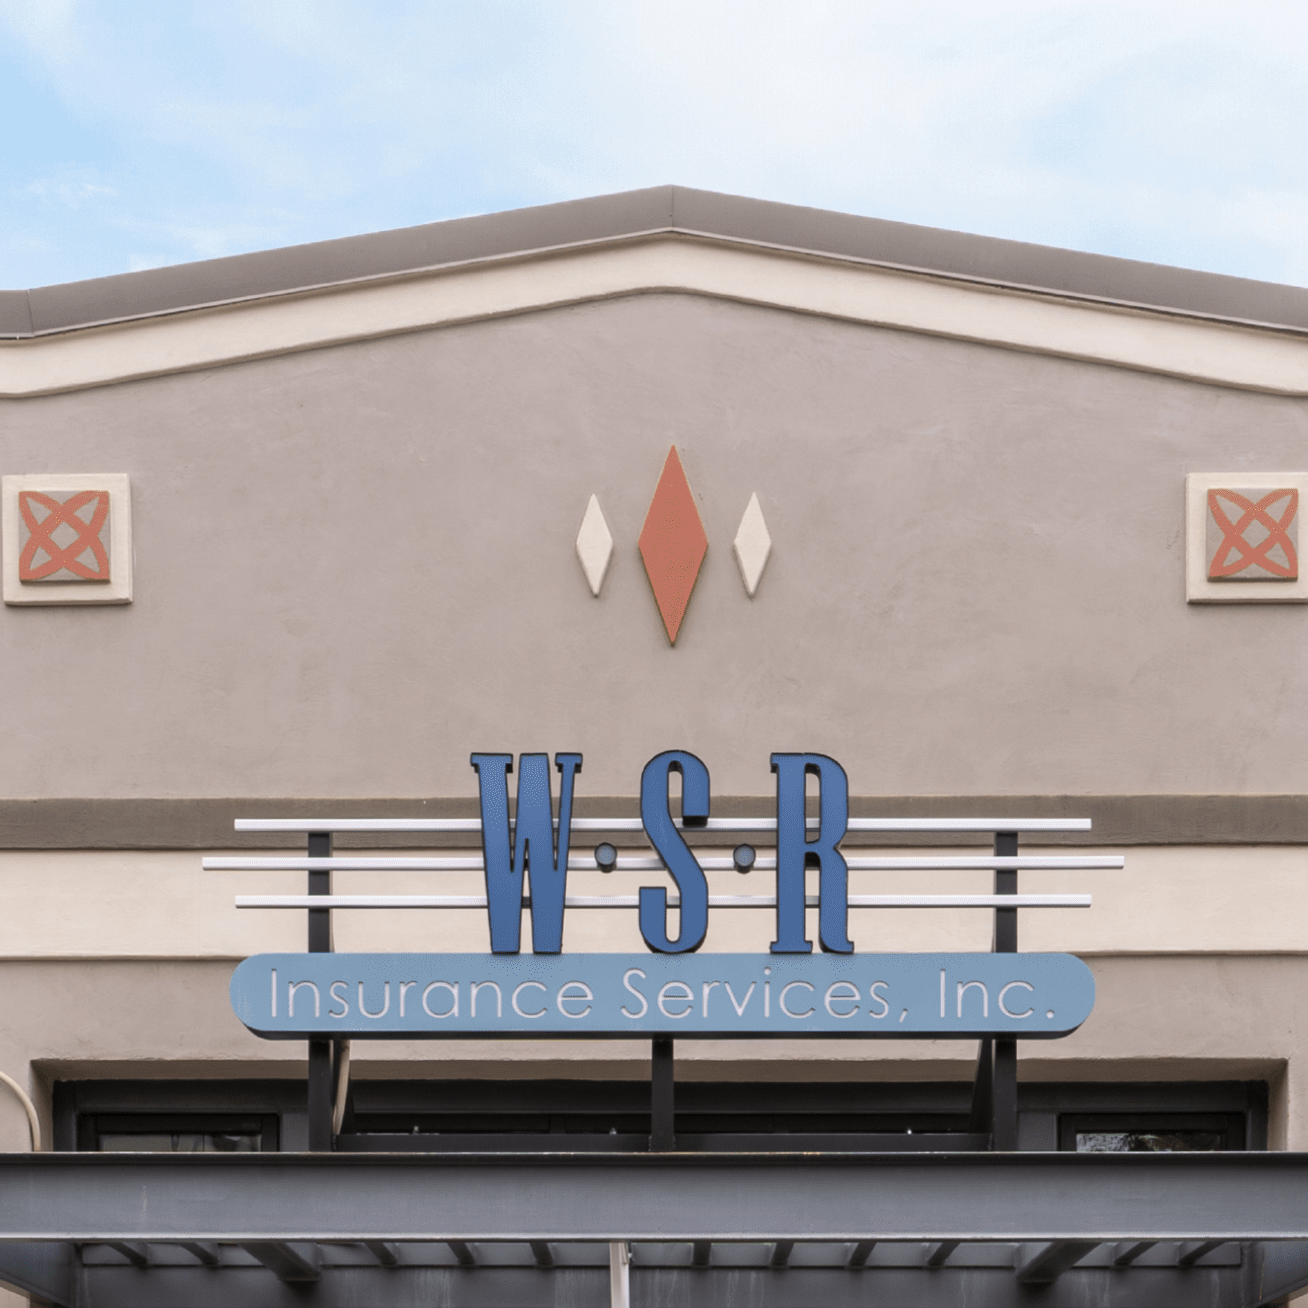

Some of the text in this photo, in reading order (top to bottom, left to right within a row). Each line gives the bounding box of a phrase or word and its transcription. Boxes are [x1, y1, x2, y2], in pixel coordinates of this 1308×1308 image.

[268, 965, 1056, 1023] Insurance Services, Inc.
